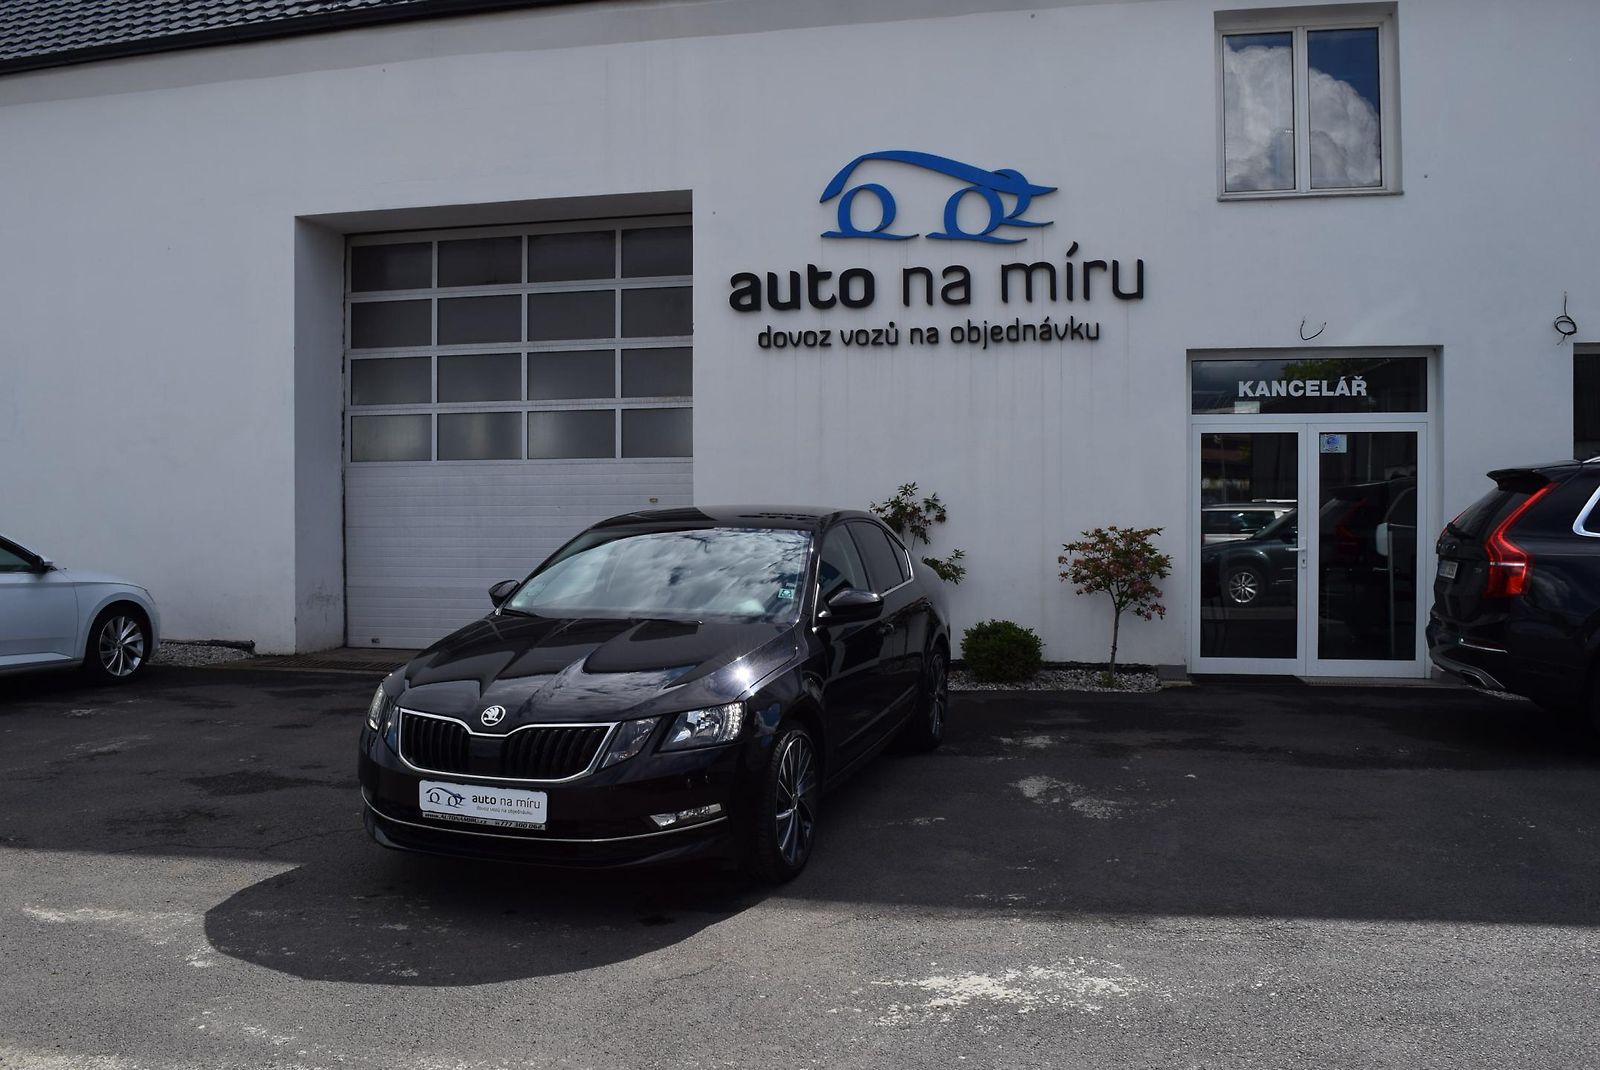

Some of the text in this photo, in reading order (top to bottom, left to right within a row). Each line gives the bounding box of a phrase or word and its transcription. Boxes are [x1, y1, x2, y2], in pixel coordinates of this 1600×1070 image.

[729, 241, 1145, 313] auto na míru
[757, 315, 1100, 351] dovoz vozů na objednávku
[1237, 374, 1368, 397] KANCELÁŘ
[471, 794, 541, 809] auto na míru
